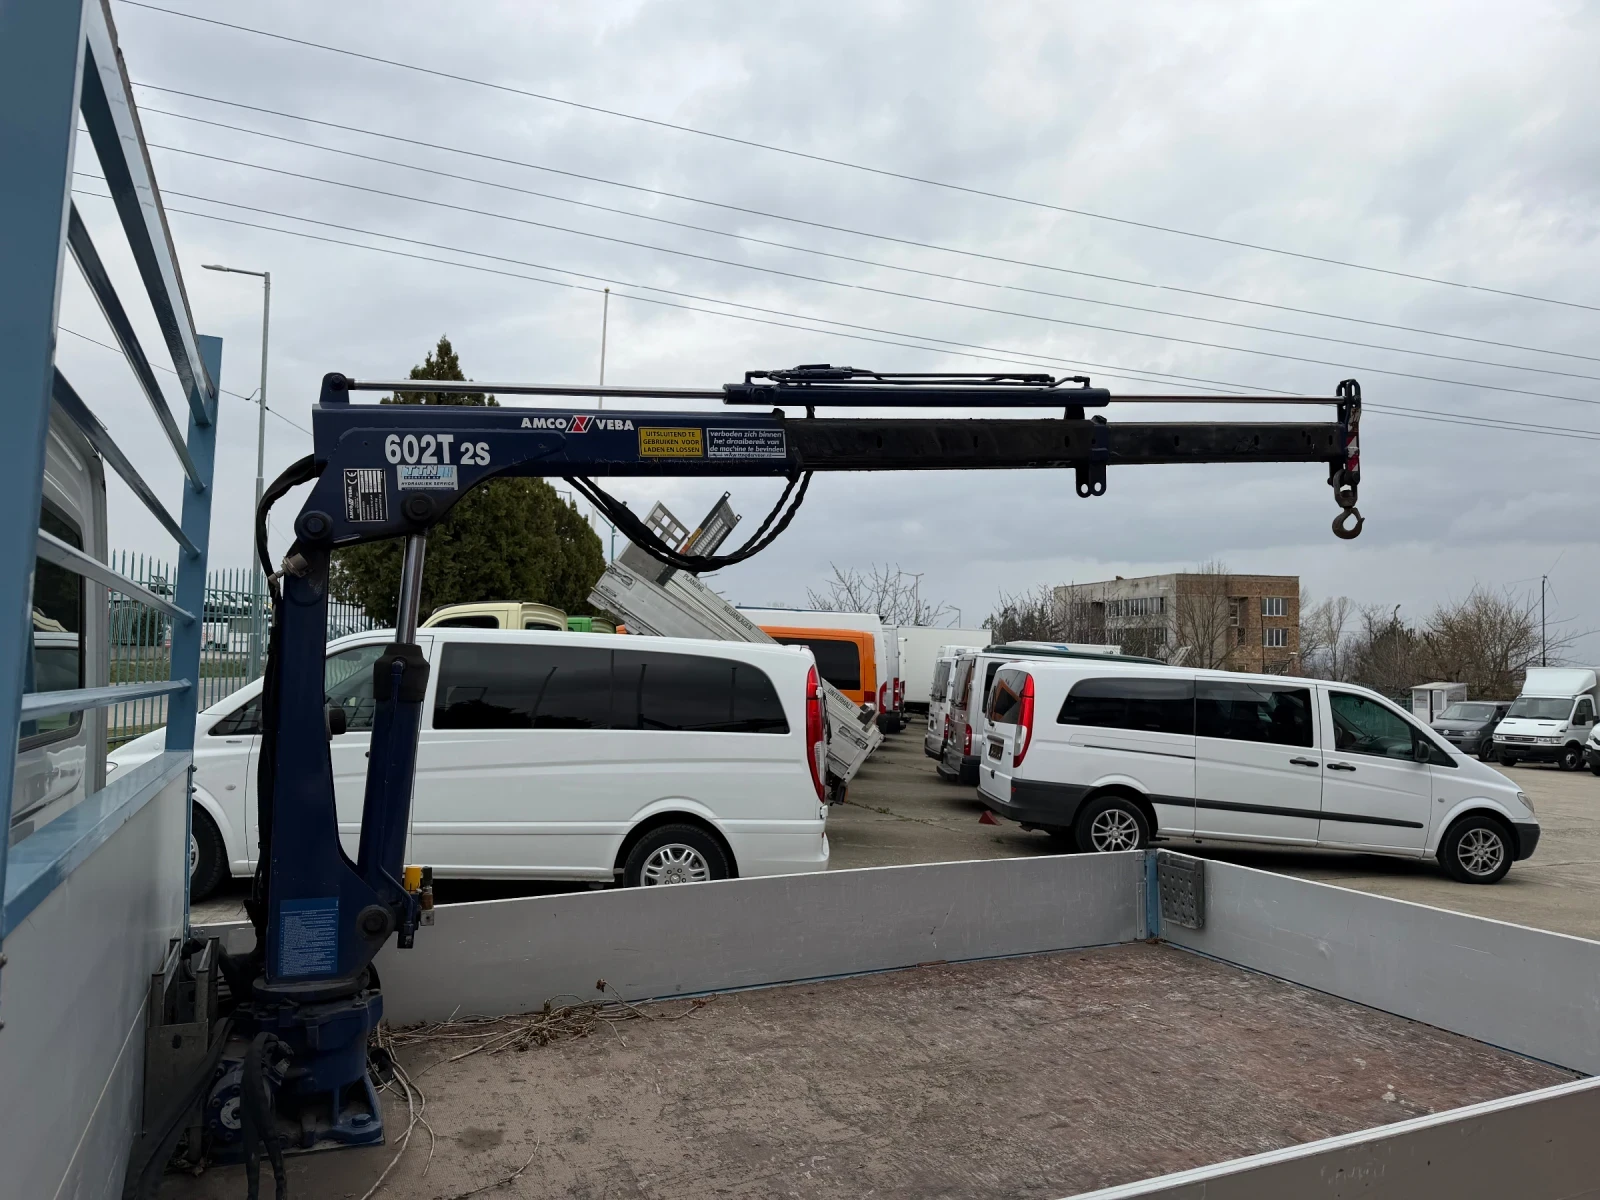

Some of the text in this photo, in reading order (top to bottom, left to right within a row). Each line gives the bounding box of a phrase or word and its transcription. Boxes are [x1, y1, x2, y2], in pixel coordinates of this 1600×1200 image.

[520, 417, 635, 431] AMCO VEBA
[710, 430, 743, 438] verboden
[744, 430, 758, 438] zich
[713, 437, 725, 445] het
[384, 433, 491, 466] 602T 2S
[405, 465, 438, 476] TTN
[683, 573, 704, 592] PLANUNG
[723, 605, 753, 631] NEUANLAGEN
[827, 687, 854, 710] UNTERHALT
